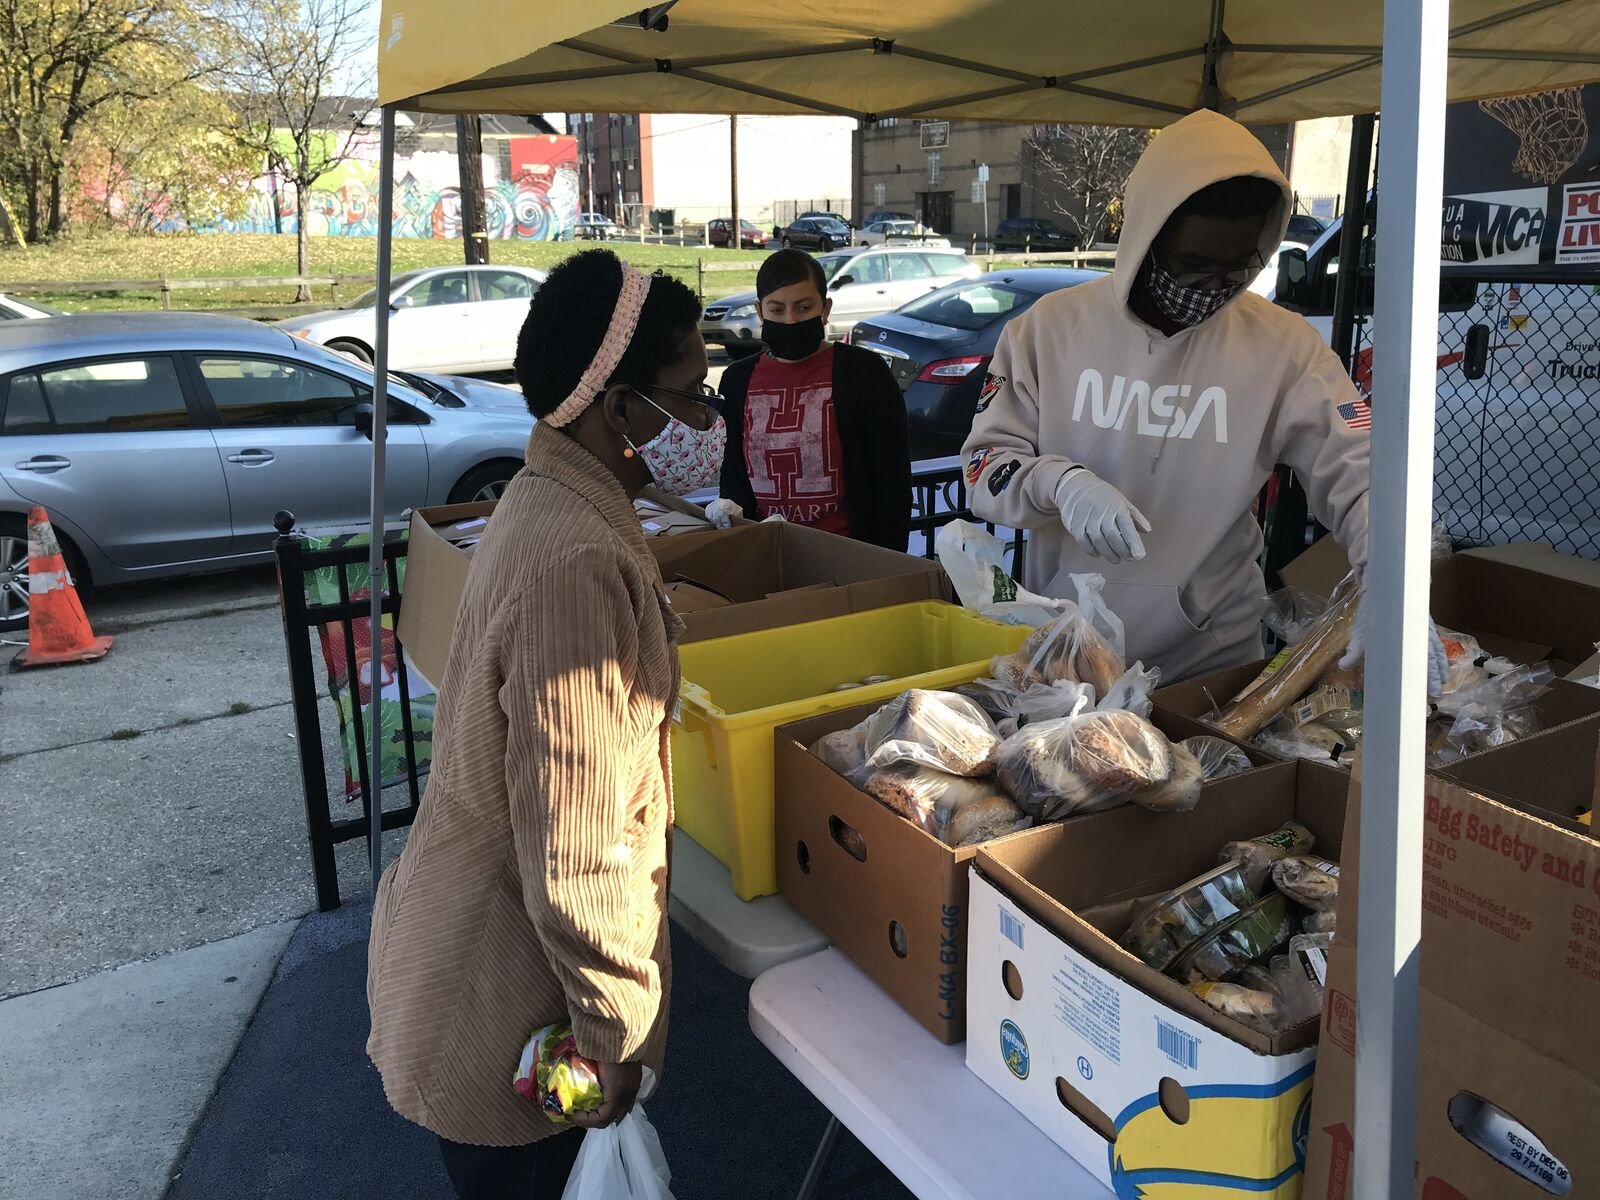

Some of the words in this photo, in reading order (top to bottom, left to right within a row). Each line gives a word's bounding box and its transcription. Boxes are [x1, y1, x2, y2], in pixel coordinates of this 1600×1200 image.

[1072, 368, 1228, 444] NASA
[744, 382, 838, 500] H
[1424, 796, 1463, 840] Egg
[1466, 813, 1538, 872] Safety
[1541, 851, 1586, 889] and
[1429, 889, 1476, 921] sanitized
[1478, 914, 1521, 943] utensils
[1453, 884, 1506, 918] uncracked
[1508, 911, 1532, 931] eggs
[1527, 1145, 1540, 1159] BY
[1539, 1153, 1557, 1171] DEC
